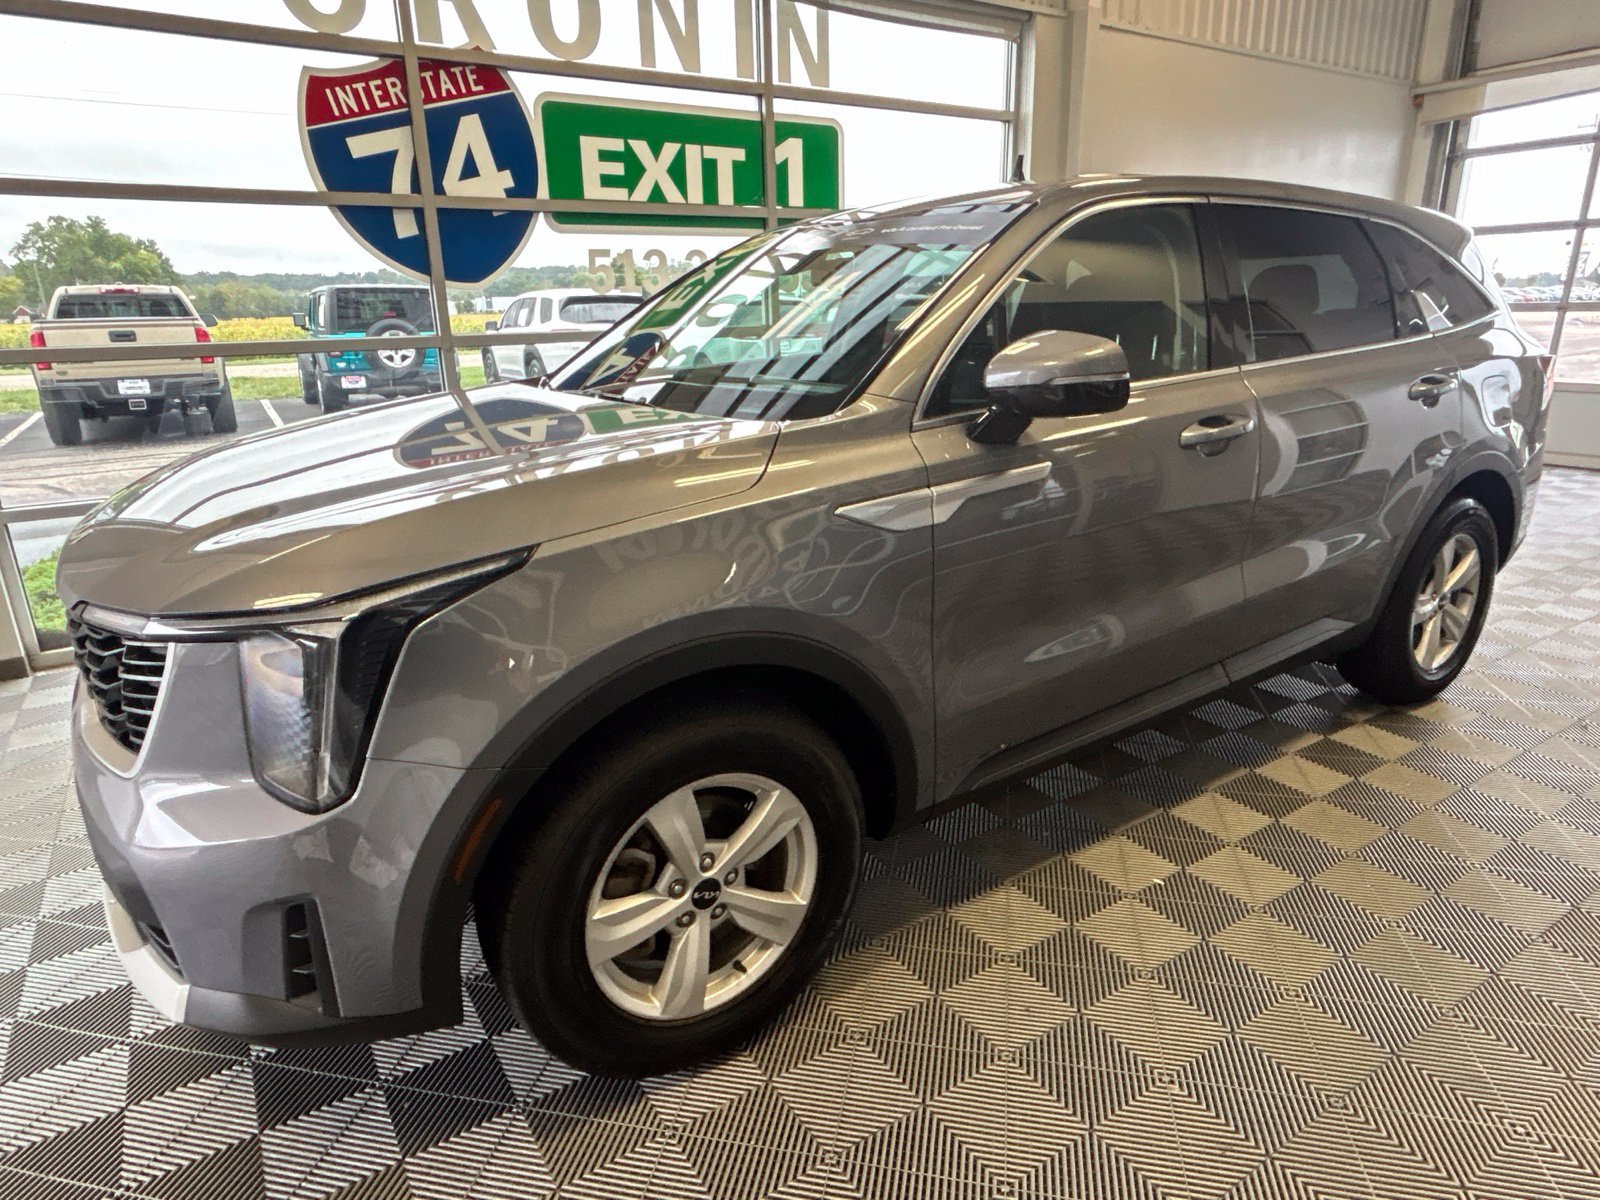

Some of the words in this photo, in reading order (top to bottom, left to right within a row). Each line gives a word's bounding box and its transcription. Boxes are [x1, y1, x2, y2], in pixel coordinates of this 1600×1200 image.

[345, 113, 515, 239] 74
[579, 135, 746, 207] EXIT
[775, 137, 804, 208] 1
